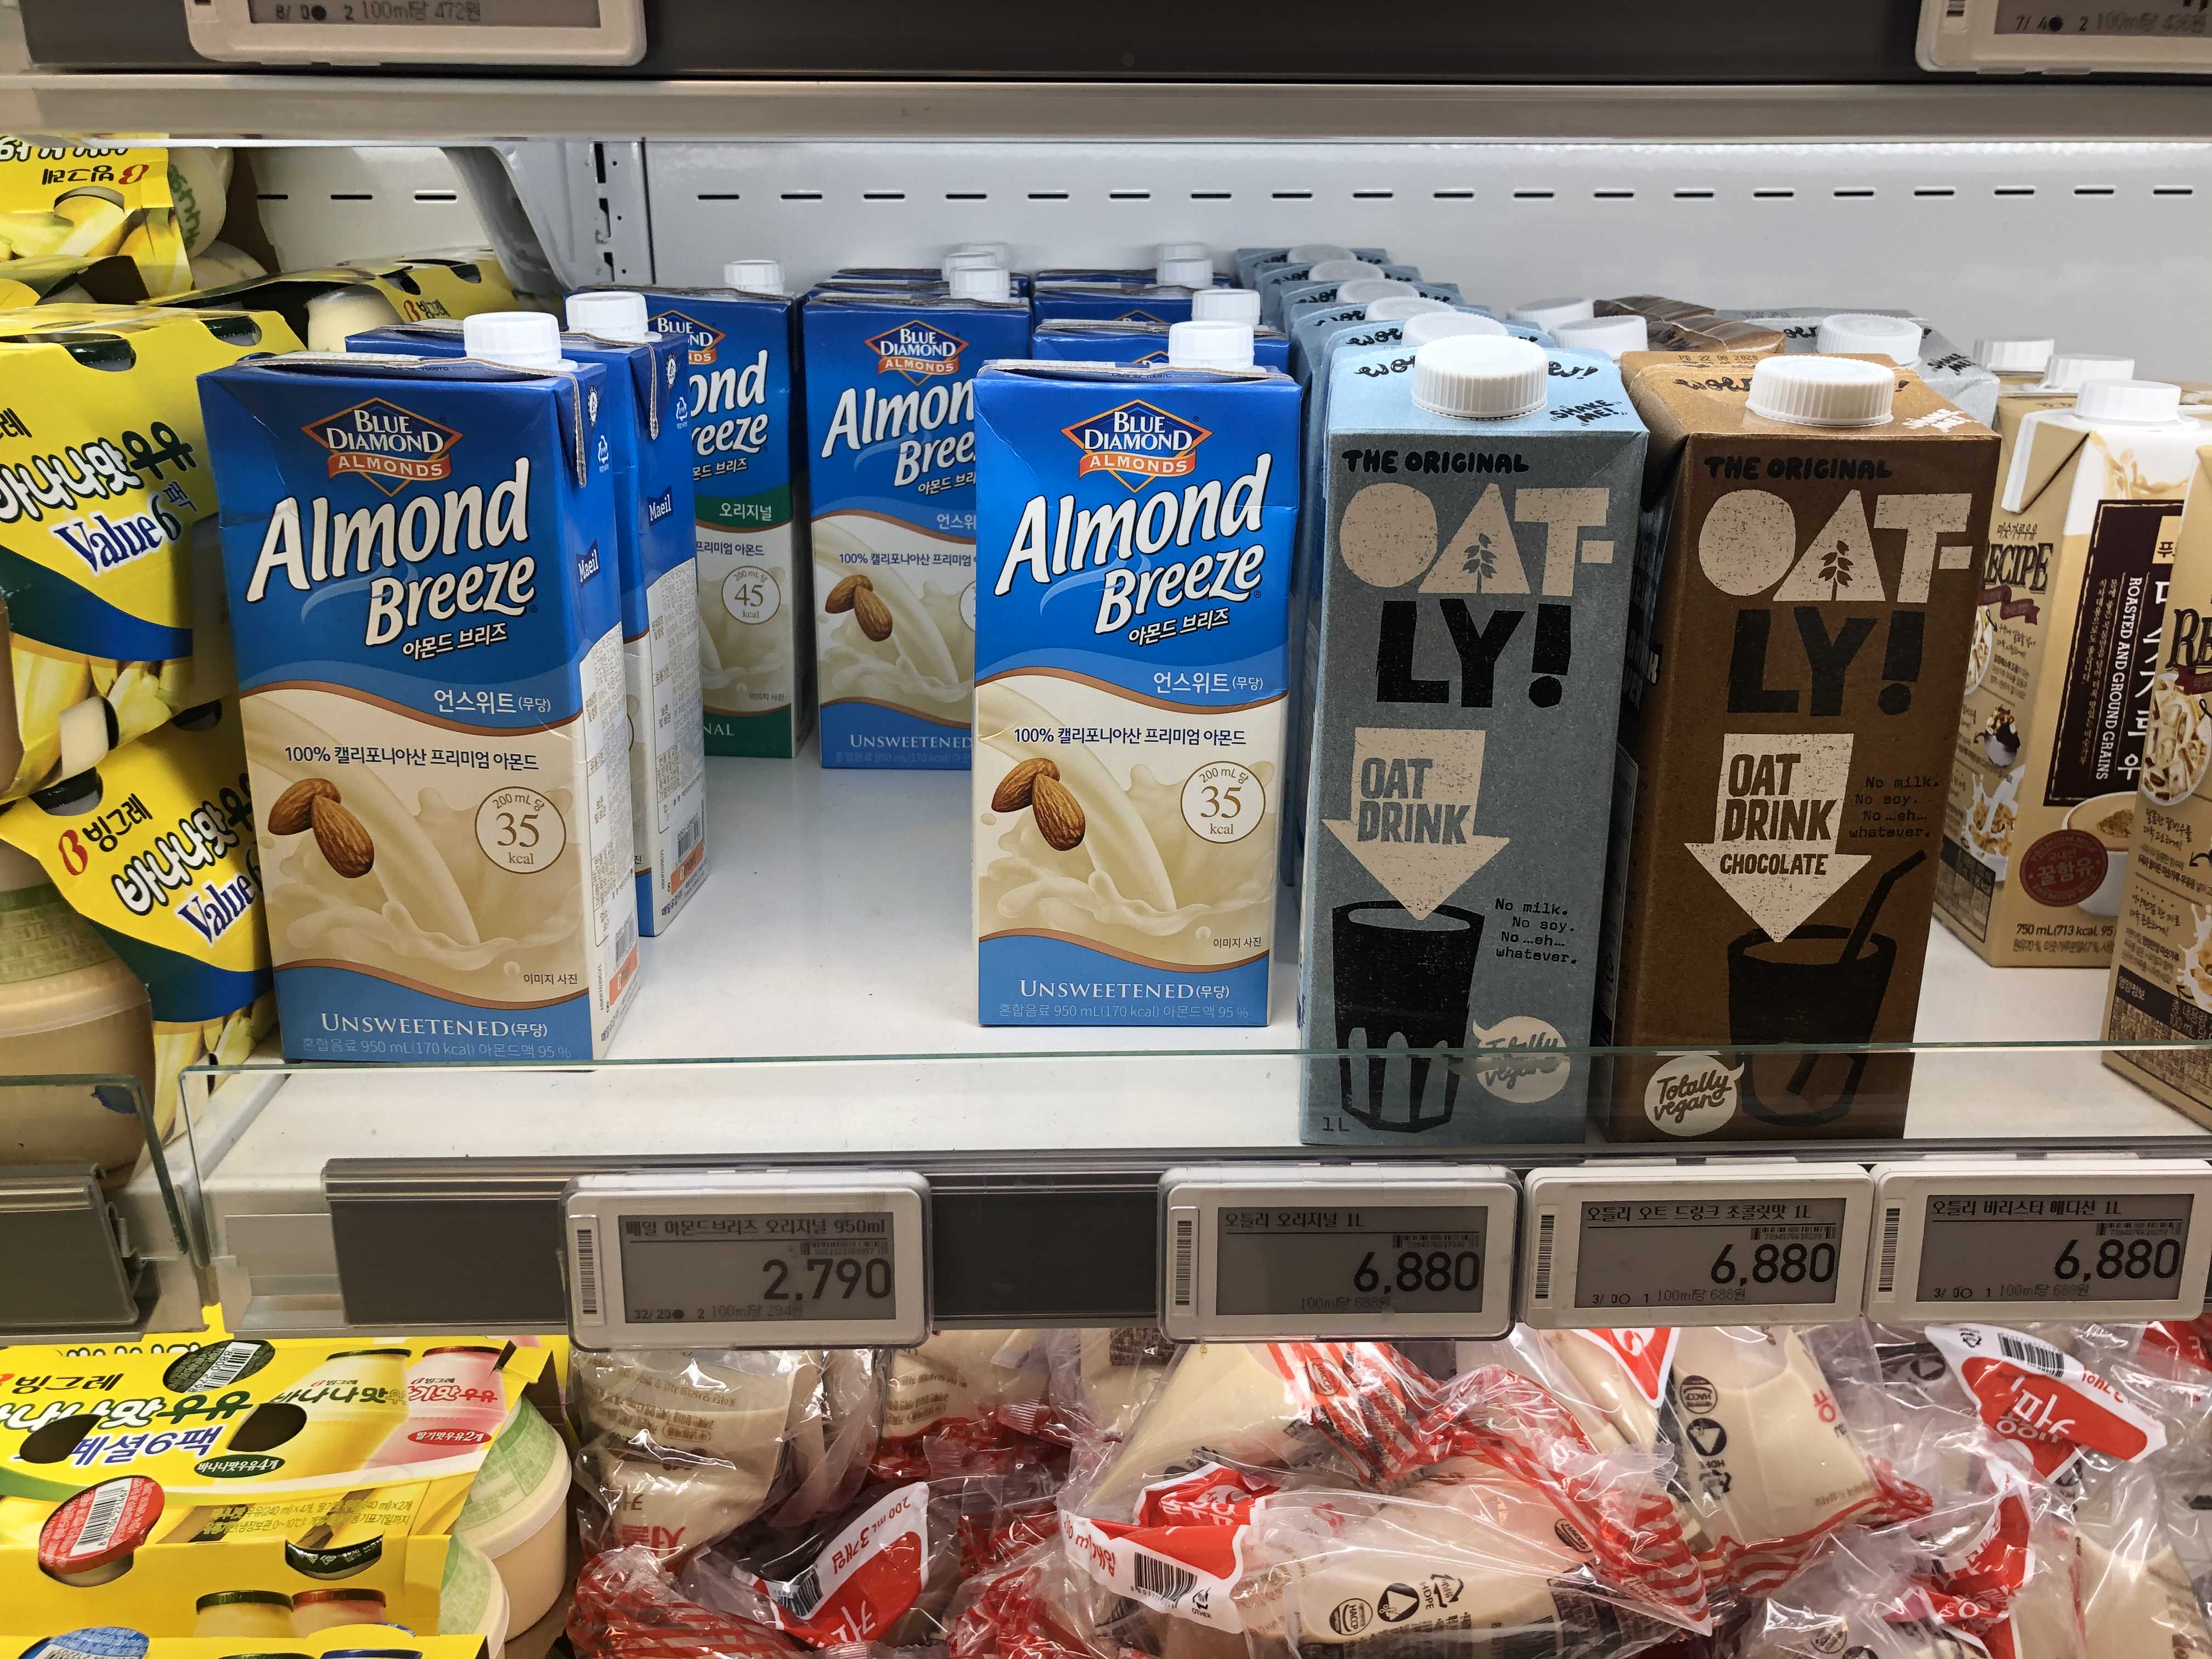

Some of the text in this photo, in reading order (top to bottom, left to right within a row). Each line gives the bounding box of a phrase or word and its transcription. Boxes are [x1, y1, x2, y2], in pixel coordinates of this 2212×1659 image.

[658, 318, 693, 334] BLUE
[900, 329, 936, 345] BLUE
[881, 340, 956, 357] DIAMOND
[885, 359, 953, 373] ALMONDS
[691, 350, 768, 417] ond
[821, 378, 974, 458] Almon
[1549, 400, 1614, 419] SHAKE
[1576, 408, 1619, 423] ME!
[354, 410, 413, 435] BLUE
[1114, 412, 1165, 433] BLUE
[327, 426, 444, 454] DIAMOND
[692, 414, 768, 456] reeze
[1084, 429, 1193, 451] DIAMOND
[337, 456, 443, 477] ALMONDS
[714, 458, 747, 476] 브리즈
[1089, 455, 1187, 473] ALMONDS
[1342, 449, 1530, 474] THE ORIGINAL
[1704, 456, 1893, 480] THE ORIGINAL
[918, 478, 952, 495] 아몬드
[650, 494, 672, 521] Maeil
[719, 503, 772, 521] 오리지널
[246, 457, 530, 603] Almond
[994, 453, 1272, 596] Almond
[696, 541, 765, 556] 프리미엄 아몬드
[839, 553, 868, 564] 100%
[933, 554, 971, 567] 프리미엄
[578, 549, 599, 582] Maeil
[1984, 542, 2055, 595] ECIPE
[365, 555, 536, 646] Breeze
[734, 584, 764, 607] 45
[1094, 544, 1264, 634] Breeze
[742, 610, 760, 619] kcal
[2120, 577, 2142, 639] ROASTED
[1128, 608, 1229, 646] 아몬드 브리즈
[403, 623, 507, 661] 아몬드 브리즈
[1376, 598, 1571, 708] LY!
[1726, 606, 1925, 716] LY!
[2114, 641, 2130, 670] AND
[1153, 672, 1263, 694] 언스위트 (무당)
[433, 690, 551, 714] 언스위트 (무당)
[2105, 672, 2125, 730] GROUND
[1014, 728, 1246, 746] 100% 캘리포니아산 프리미엄 아몬드
[285, 746, 540, 771] 100% 캘리포니아산 프리미엄 아몬드
[2096, 731, 2116, 780] GRAINS
[1199, 768, 1249, 785] 200 mL 당
[1360, 758, 1434, 799] OAT
[1729, 753, 1801, 797] OAT
[1865, 775, 1940, 788] No milk.
[493, 792, 547, 811] 200 mL 당
[1200, 786, 1242, 818] 35
[1855, 794, 1919, 808] No soy.
[82, 793, 153, 852] 빙그레
[495, 812, 540, 848] 35
[1210, 823, 1234, 836] kcal
[1356, 800, 1472, 845] DRINK
[1722, 799, 1837, 841] DRINK
[1849, 828, 1931, 838] whatever.
[508, 851, 535, 867] kcal
[1720, 853, 1827, 876] CHOCOLATE
[1495, 898, 1568, 916] No milk.
[1513, 916, 1575, 934] No soy.
[2017, 923, 2035, 935] 750
[1212, 936, 1261, 949] 이미지 사진
[1500, 932, 1519, 944] No
[1496, 946, 1577, 965] whatever.
[523, 973, 579, 986] 이미지 사진
[999, 1003, 1249, 1020] 혼합음료 950 아몬드액 95 %
[302, 1037, 357, 1054] 혼합음료
[360, 1039, 386, 1054] 950
[538, 1046, 555, 1059] 95
[1656, 1069, 1732, 1103] Totally
[1654, 1091, 1725, 1124] vegan
[1586, 1204, 1812, 1222] 오틀리 오트 드링크 초콜릿맛 1L
[1931, 1200, 2121, 1216] 오틀리 바리스타 에디션 1L
[625, 1218, 885, 1236] 매일 아몬드브리즈 오리지널 950ml
[1225, 1212, 1364, 1228] 오틀리 오리지널 1L
[1711, 1243, 1836, 1286] 6,880
[2053, 1238, 2181, 1283] 6,880
[1353, 1251, 1480, 1295] 6,880
[11, 1373, 124, 1394] 빙그레
[888, 1496, 911, 1520] 200
[832, 1526, 870, 1576] 3개입
[1419, 1581, 1435, 1610] HDPE
[1191, 1607, 1212, 1620] OTHER
[1348, 1605, 1358, 1629] HACCP
